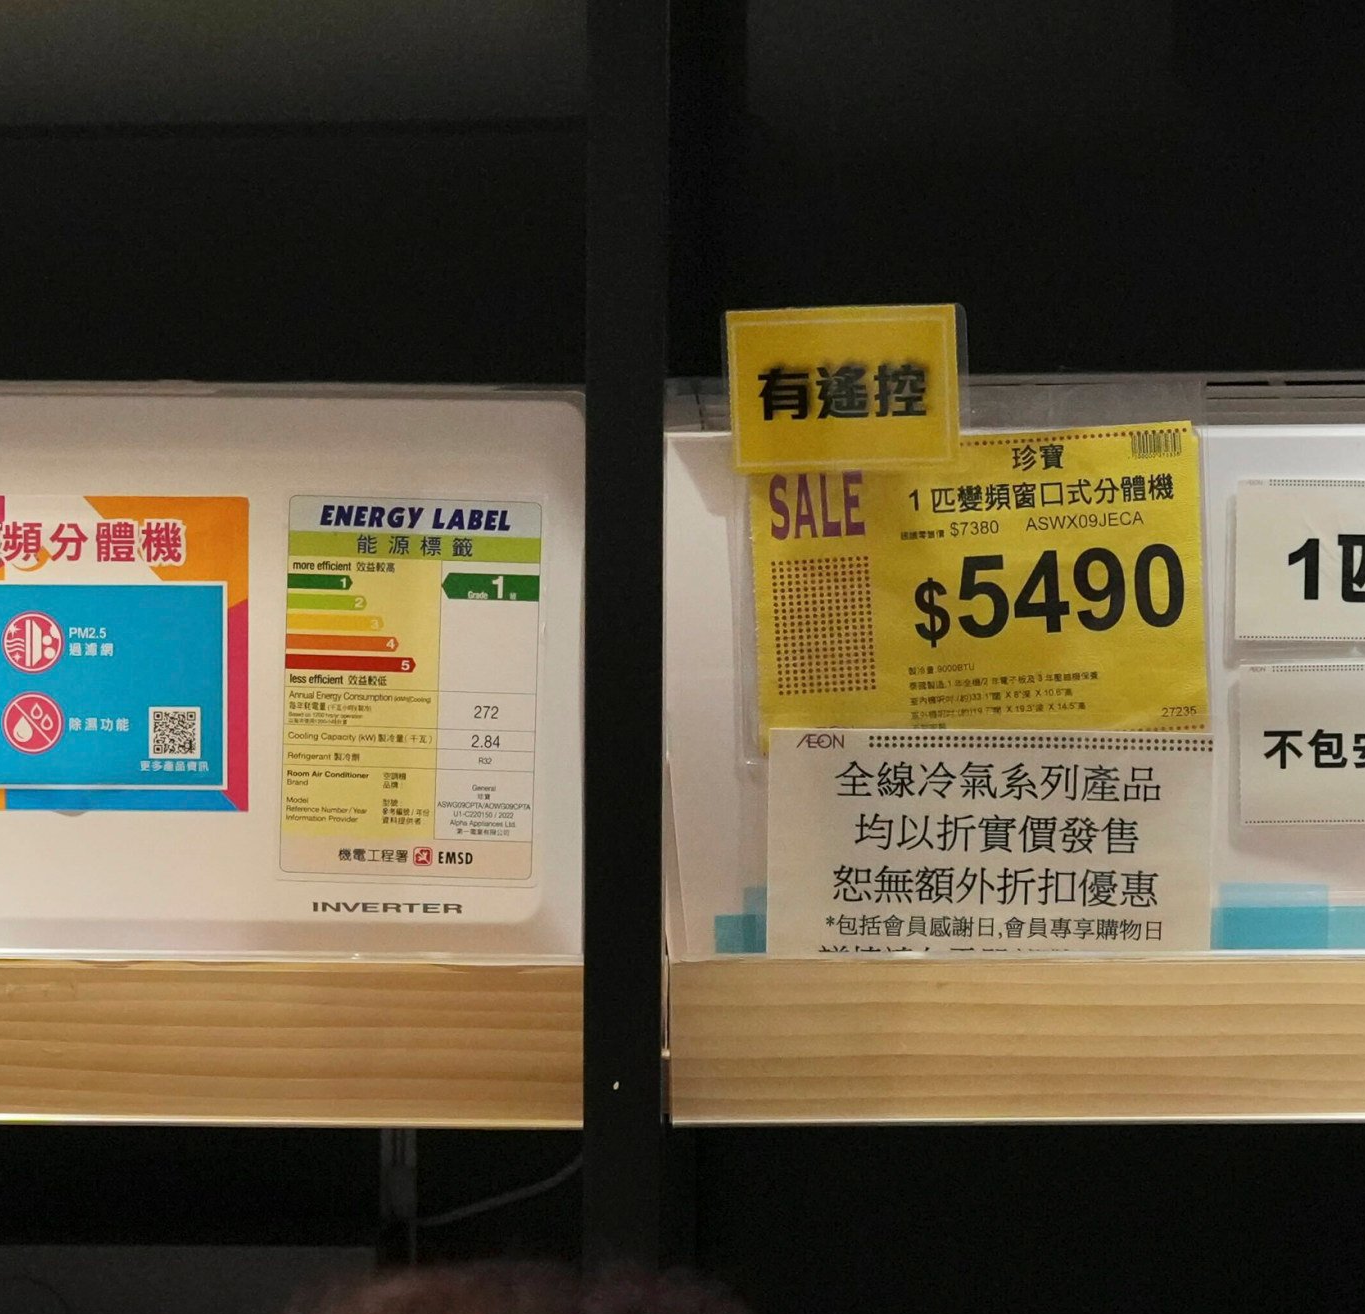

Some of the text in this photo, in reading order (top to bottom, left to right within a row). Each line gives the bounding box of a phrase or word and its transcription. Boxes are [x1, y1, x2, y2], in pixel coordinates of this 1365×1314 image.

[757, 363, 927, 421] 有遙控
[1012, 444, 1064, 471] 珍寶
[908, 472, 1174, 514] 1 匹變頻窗口式分體機
[768, 470, 865, 541] SALE
[320, 505, 511, 532] ENERGY LABEL
[949, 511, 1144, 537] $7380 ASWX09JECA
[357, 534, 473, 558] 能源標籤
[293, 561, 351, 572] more efficient
[356, 562, 395, 574] 效益較高
[914, 543, 1185, 648] $5490
[69, 628, 107, 640] PM2.5
[69, 642, 114, 658] 過濾網
[289, 673, 343, 686] less efficient
[348, 675, 387, 687] 效益較低
[473, 706, 499, 720] 272
[1161, 705, 1197, 718] 27235
[69, 716, 129, 732] 除濕功能
[288, 732, 356, 743] Cooling Capacity
[471, 734, 500, 748] 2.84
[287, 752, 331, 761] Refrigerant
[140, 760, 209, 772] 更多產品資訊
[835, 761, 1160, 802] 全線冷氣系列產品
[854, 814, 1139, 855] 均以折實價發售
[338, 848, 473, 865] 機電工程署 EMSD
[833, 865, 1159, 908] 恕無額外折扣優惠
[312, 902, 462, 915] INVERTER
